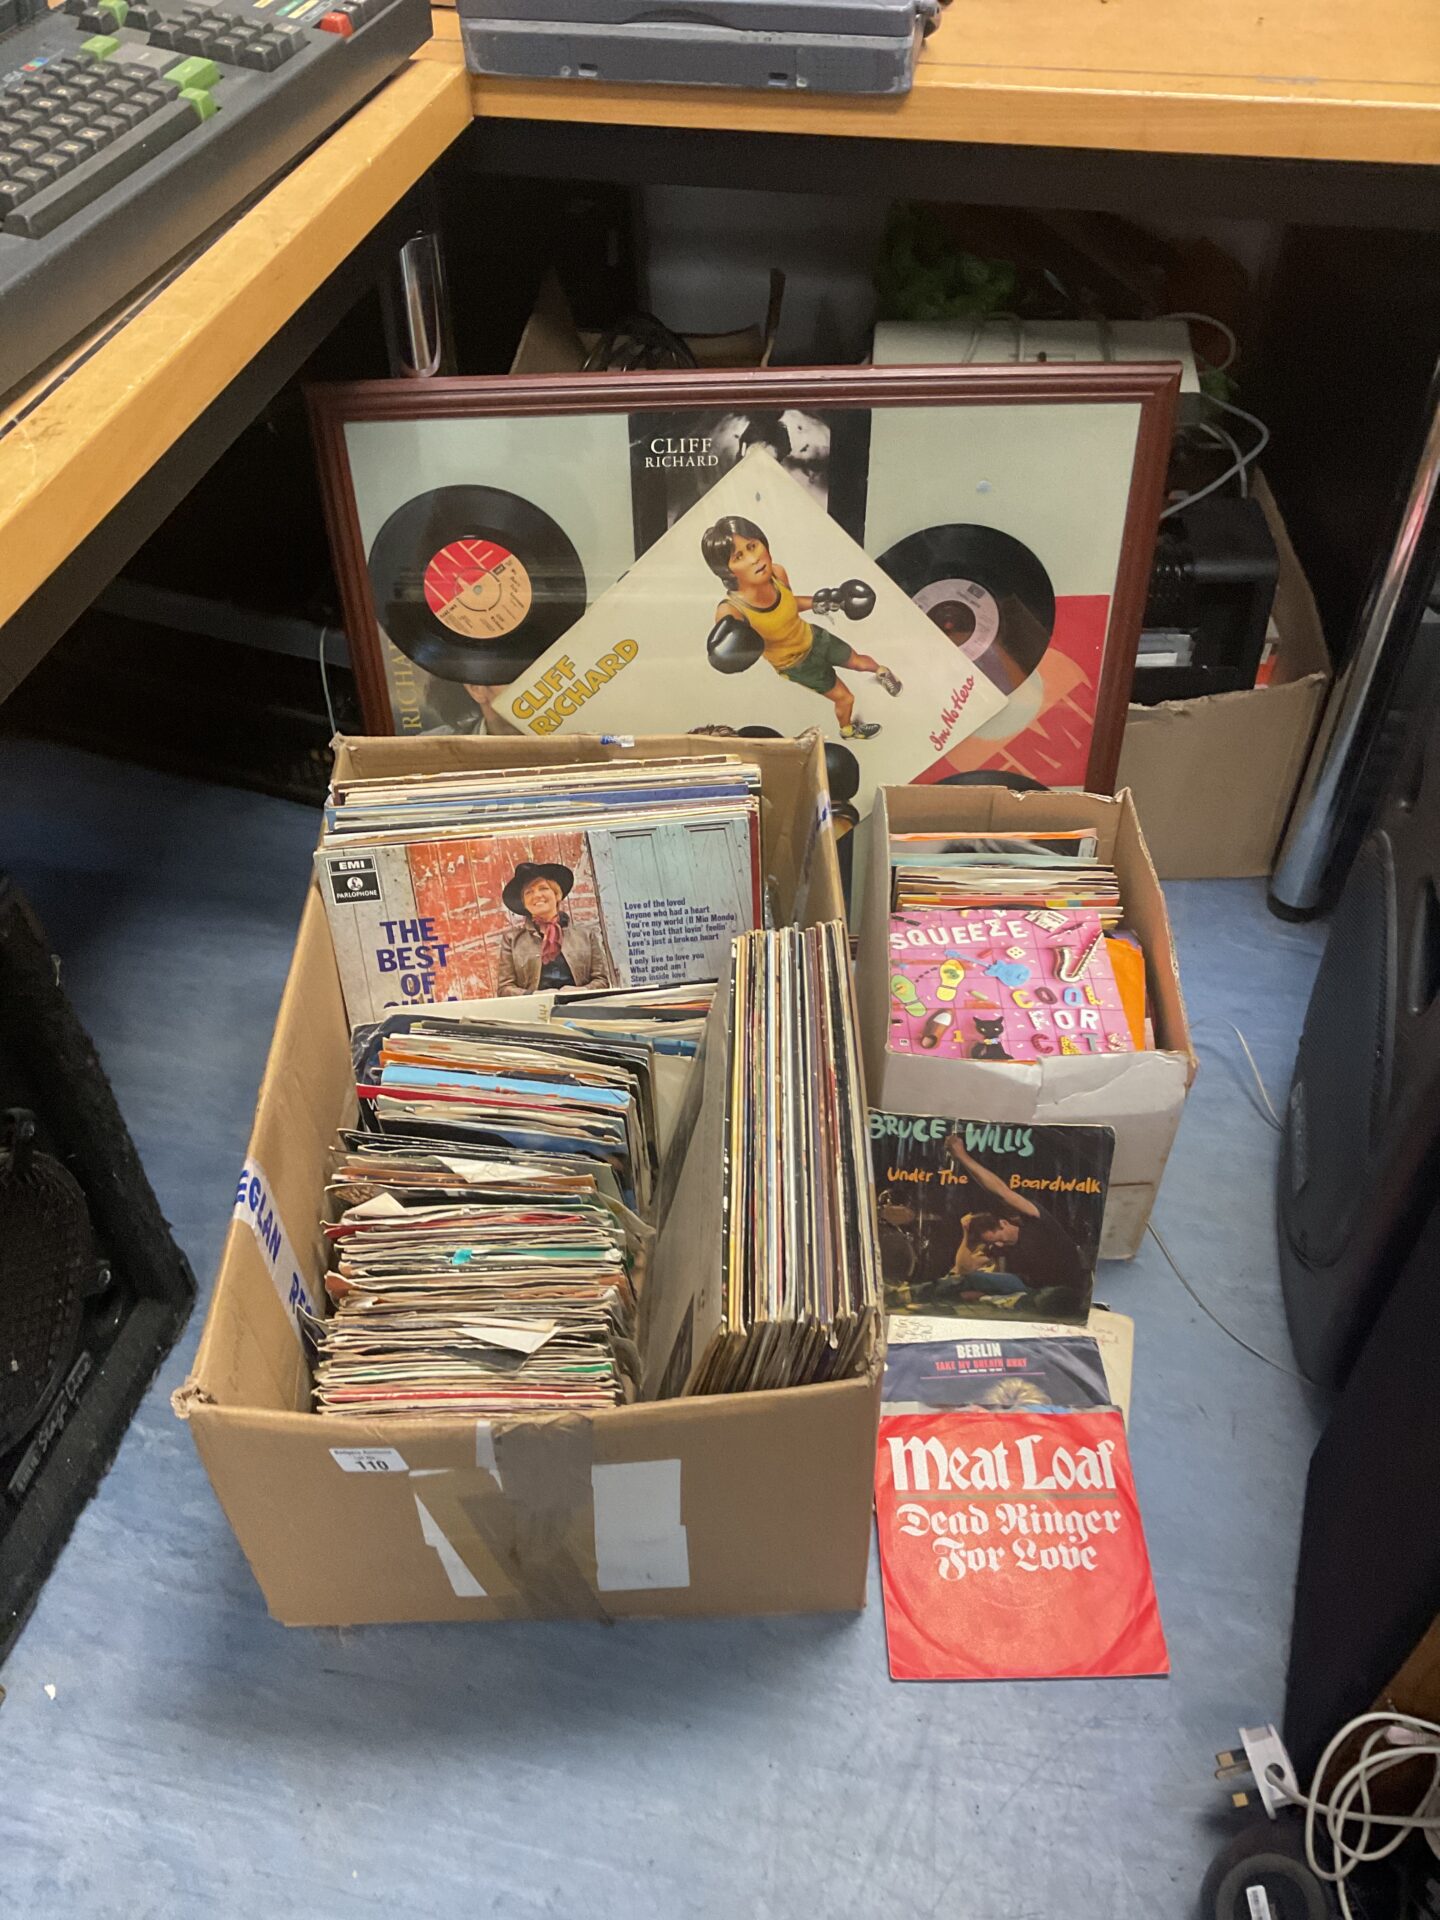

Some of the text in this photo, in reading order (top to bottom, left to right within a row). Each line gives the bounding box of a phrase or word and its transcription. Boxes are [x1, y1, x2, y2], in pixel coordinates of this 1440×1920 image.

[651, 438, 712, 454] CLIFF
[645, 455, 718, 468] RICHARD
[389, 640, 422, 728] RICHA
[512, 654, 576, 719] CLIFF
[528, 639, 639, 736] RICHARD
[929, 675, 974, 751] I'm No Hero
[339, 860, 365, 870] EMI
[336, 890, 378, 899] PARLOPHONE
[624, 898, 686, 910] Love of the loved
[626, 911, 651, 920] Anyone
[653, 909, 667, 917] who
[690, 906, 710, 914] heart
[626, 920, 649, 929] You're
[652, 920, 661, 928] my
[664, 918, 683, 926] world
[696, 915, 708, 924] Mio
[710, 913, 737, 922] Mondo)
[380, 918, 438, 944] THE
[627, 923, 727, 938] You've lost that lovin' feelin'
[628, 939, 650, 947] Love's
[652, 938, 666, 946] just
[674, 935, 698, 943] broken
[700, 933, 719, 942] heart
[889, 918, 1028, 949] SQUEEZE
[376, 944, 450, 972] BEST
[629, 948, 645, 956] Alfie
[635, 956, 649, 964] only
[651, 955, 664, 963] live
[675, 952, 689, 960] love
[630, 965, 648, 974] What
[651, 963, 668, 973] good
[631, 975, 646, 983] Step
[649, 972, 669, 980] inside
[401, 972, 436, 996] OF
[1011, 985, 1103, 1009] COOL
[1028, 1009, 1100, 1031] FOR
[1030, 1032, 1126, 1056] CATS
[870, 1114, 1034, 1157] BRUCE WILLIS
[887, 1167, 1102, 1194] Under The Boardwalk
[956, 1342, 1003, 1359] BERLIN
[356, 1460, 389, 1470] 110
[886, 1434, 1117, 1491] Meat Loaf
[896, 1502, 1120, 1544] Dead Ringer
[932, 1536, 1098, 1581] For Love
